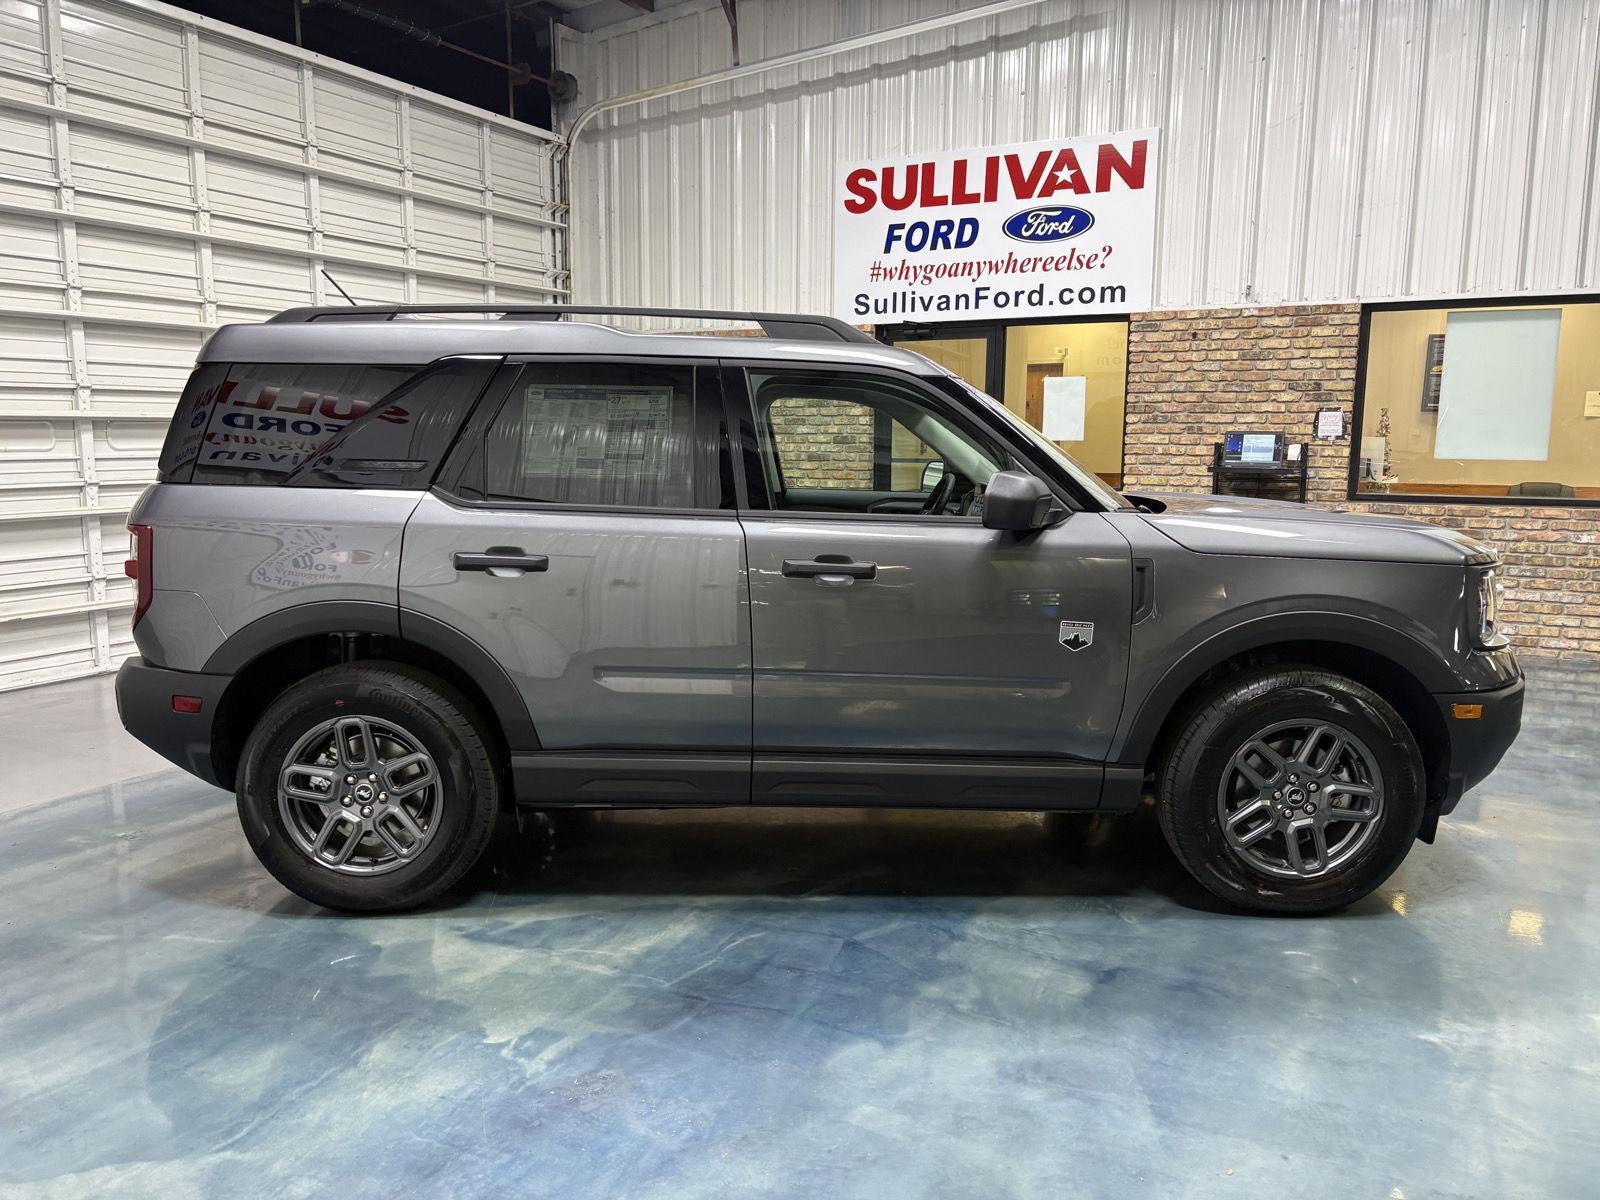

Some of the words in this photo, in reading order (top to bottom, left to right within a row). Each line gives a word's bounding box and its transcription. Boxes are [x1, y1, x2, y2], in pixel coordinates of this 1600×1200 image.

[844, 139, 1148, 214] SULLIVAN
[883, 217, 980, 255] FORD
[1021, 208, 1074, 237] Ford
[869, 245, 1113, 287] #whygoanywhereelse?
[853, 284, 1127, 316] SullivanFord.com
